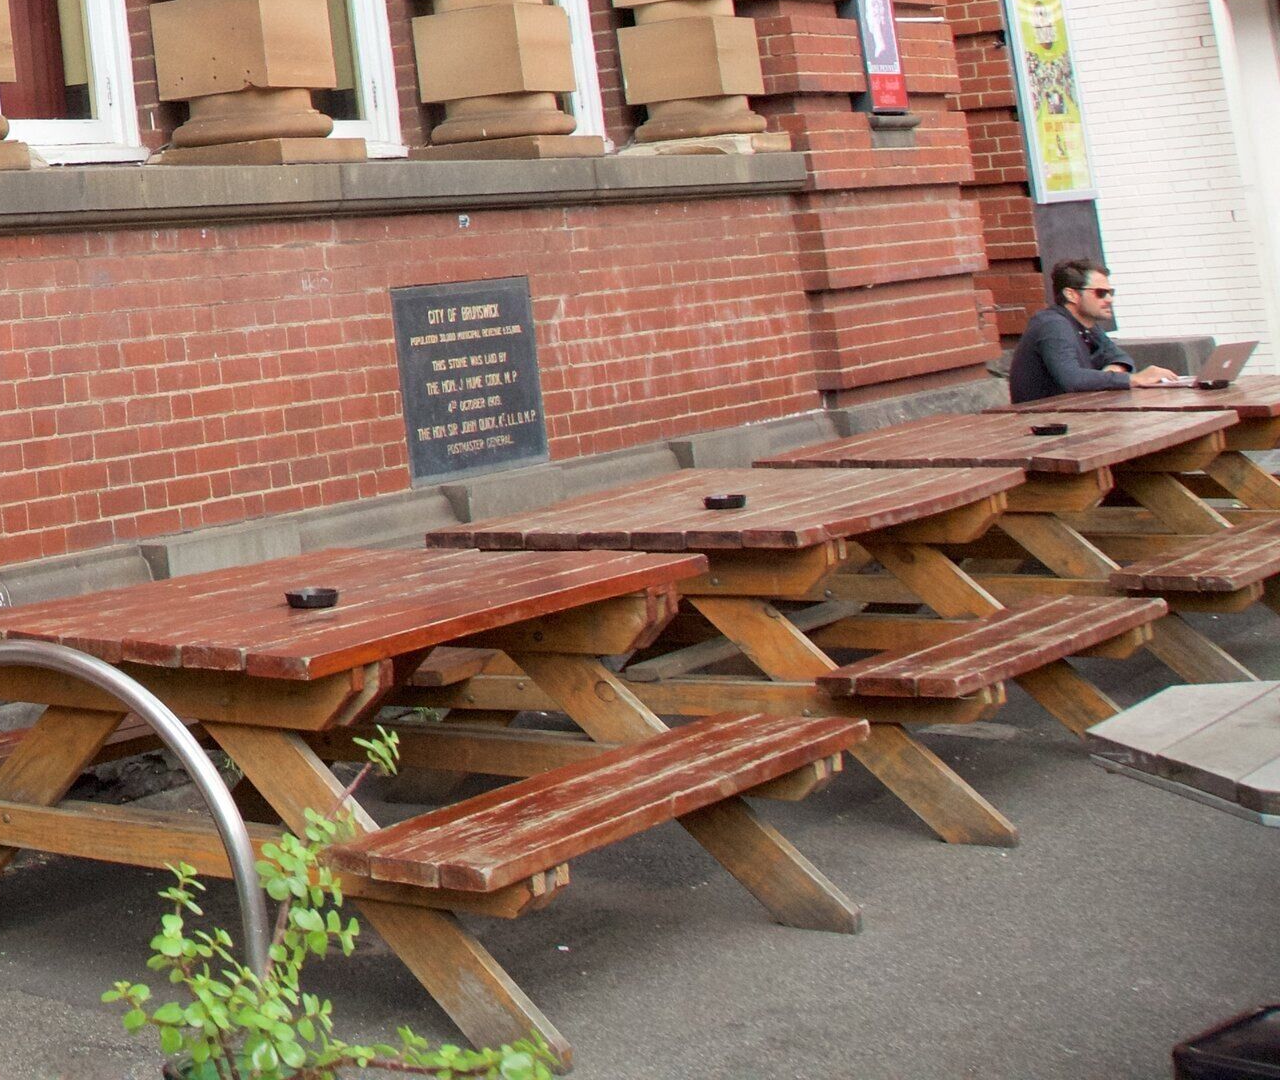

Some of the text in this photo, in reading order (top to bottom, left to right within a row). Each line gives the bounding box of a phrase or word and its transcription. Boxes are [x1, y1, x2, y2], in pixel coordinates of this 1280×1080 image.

[427, 304, 500, 324] CITY OF BRUNSWICK
[432, 352, 507, 371] THIS STONE WAS LAID BY
[426, 381, 439, 395] THE
[417, 428, 431, 441] THE
[461, 420, 478, 434] JOHN
